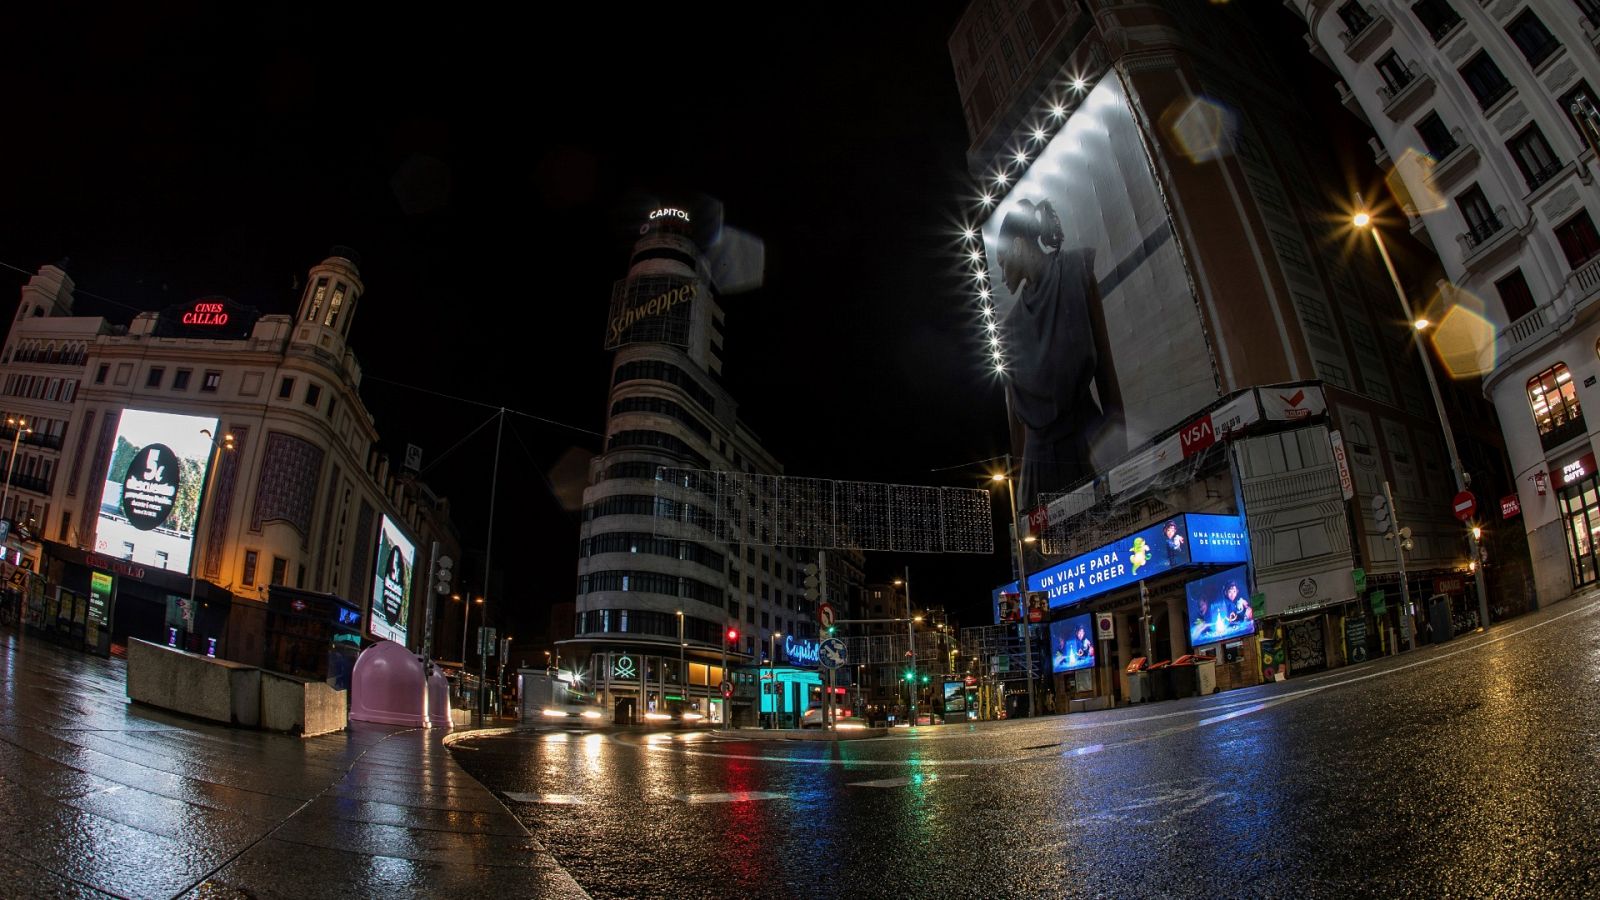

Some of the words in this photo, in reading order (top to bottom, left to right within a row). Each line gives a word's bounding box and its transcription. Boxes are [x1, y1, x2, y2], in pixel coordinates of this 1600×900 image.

[650, 208, 690, 222] CAPITOL
[195, 303, 224, 313] CINES
[607, 284, 698, 343] Schweppes
[183, 312, 228, 325] CALLAO
[1182, 421, 1212, 447] VSA
[1563, 460, 1581, 474] FIVE
[1564, 467, 1585, 483] GUYS
[1502, 500, 1516, 510] FIVE
[1503, 505, 1519, 515] GUYS
[1211, 531, 1244, 539] PELÍCULA
[1041, 575, 1054, 588] UN
[1057, 563, 1086, 582] VIAJE
[1090, 551, 1119, 571] PARA
[1079, 578, 1085, 589] A
[1089, 564, 1125, 585] CREER
[785, 635, 820, 662] Capitol
